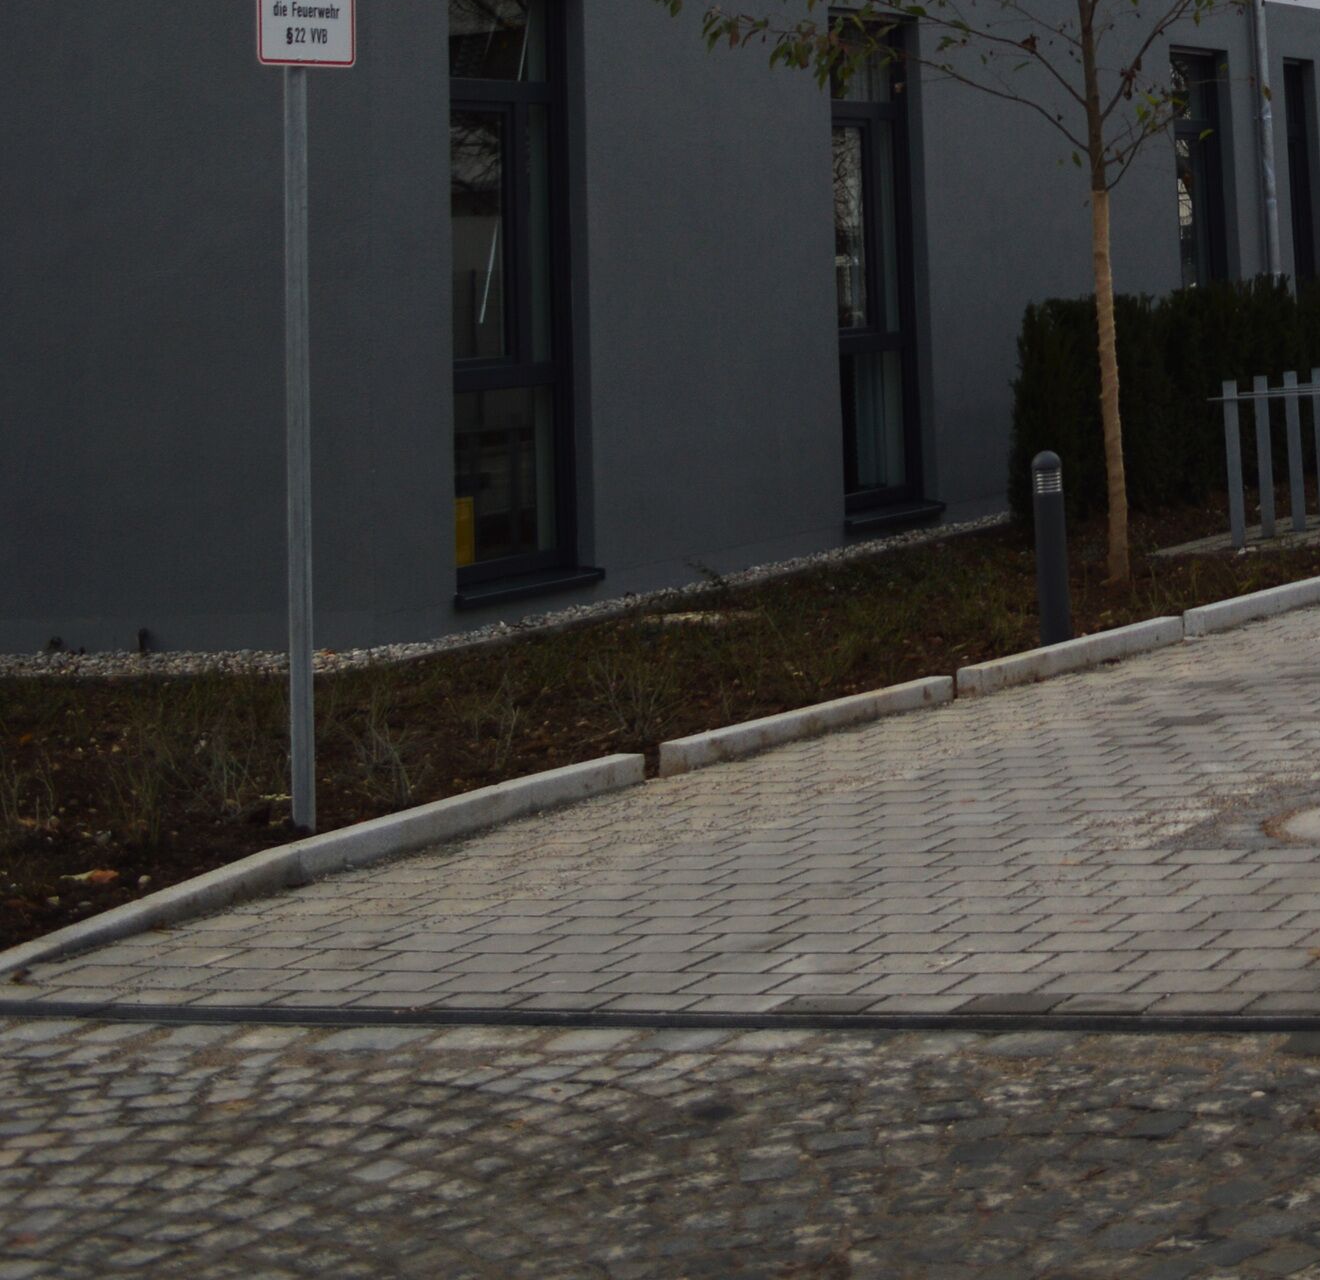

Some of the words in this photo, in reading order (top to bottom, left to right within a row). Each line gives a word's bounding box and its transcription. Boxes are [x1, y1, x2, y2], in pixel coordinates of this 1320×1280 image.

[273, 1, 287, 17] die
[291, 2, 340, 19] Feuerwehr
[310, 27, 328, 44] VVB
